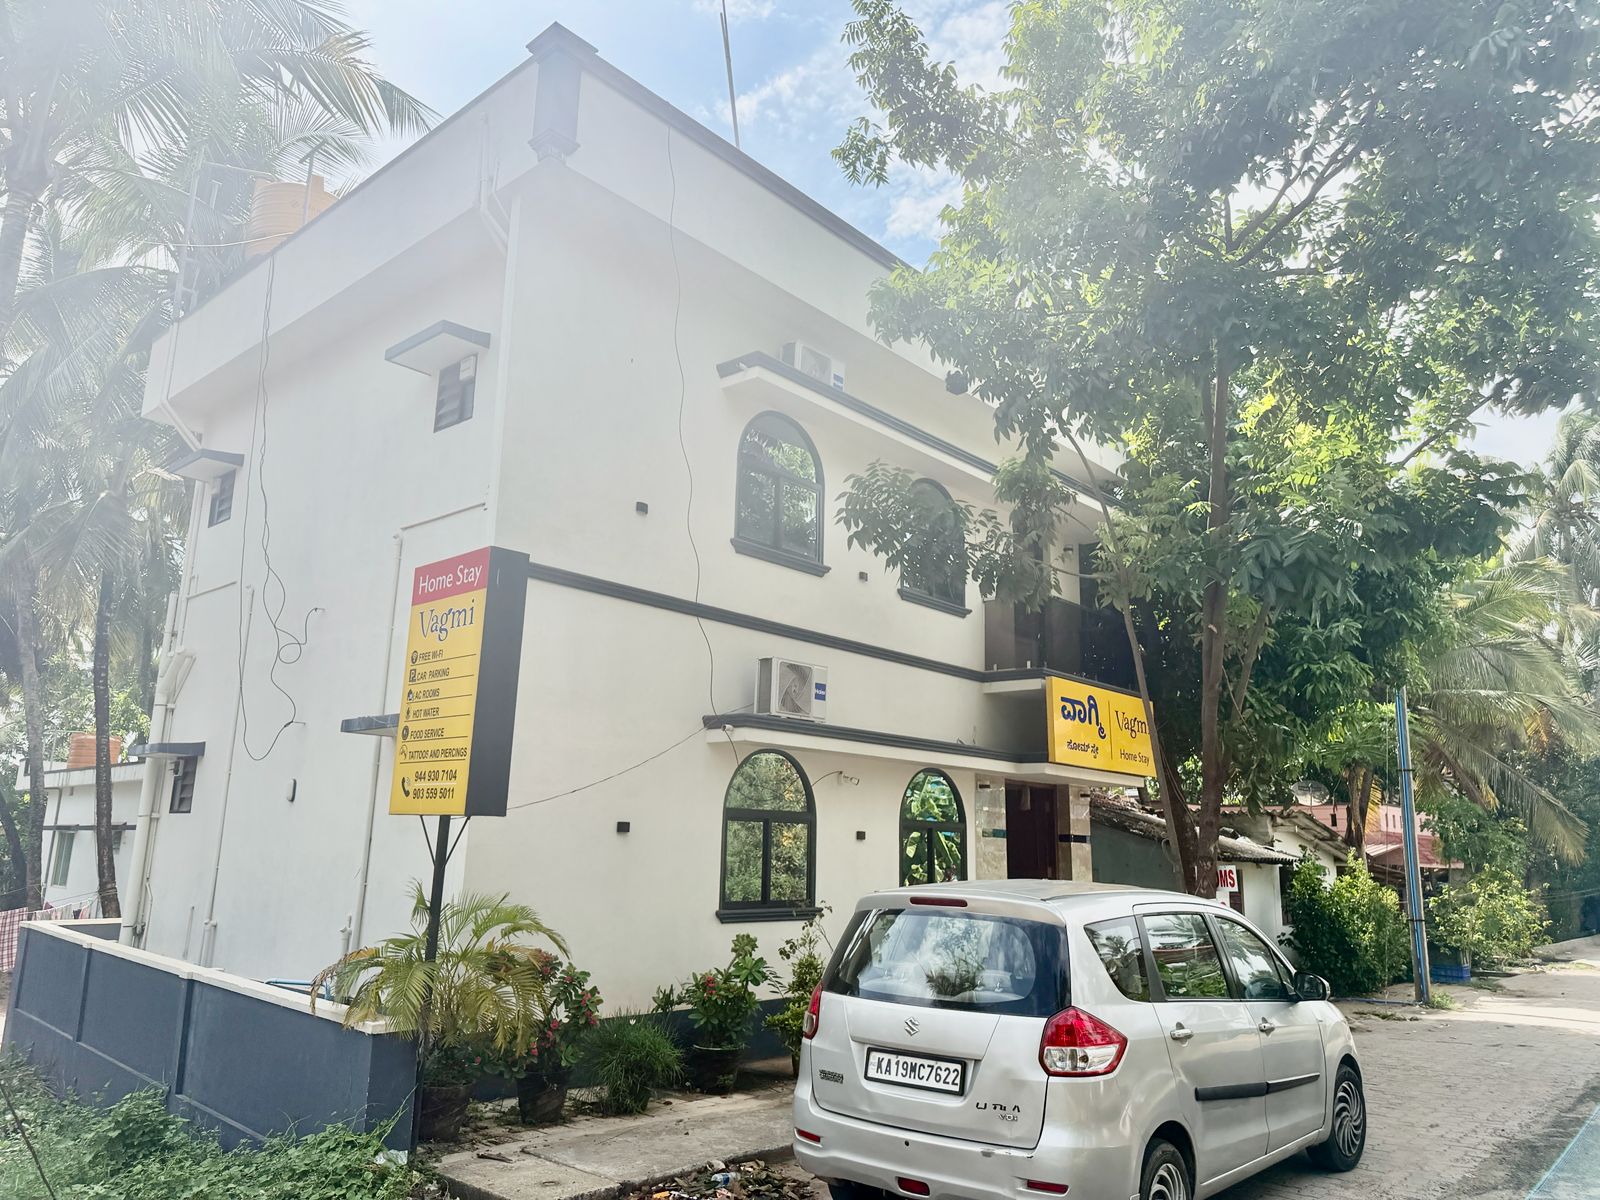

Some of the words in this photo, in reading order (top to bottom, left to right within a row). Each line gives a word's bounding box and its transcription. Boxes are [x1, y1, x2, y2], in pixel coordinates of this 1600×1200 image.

[419, 574, 453, 594] Home
[456, 564, 483, 586] Stay
[420, 598, 475, 642] Vagmi
[418, 651, 431, 661] FREE
[416, 671, 427, 681] CAR
[428, 667, 450, 679] PARKING
[414, 690, 422, 700] AC
[422, 687, 440, 699] ROOMS
[412, 708, 423, 718] HOT
[423, 706, 440, 718] WATER
[1115, 710, 1150, 739] Vagm
[410, 729, 424, 740] FOOD
[424, 727, 445, 739] SERVICE
[408, 749, 430, 760] TATTOOS
[429, 748, 441, 759] AND
[440, 747, 468, 758] PIERCINGS
[1120, 748, 1138, 762] Home
[1137, 751, 1150, 767] Stay
[414, 770, 427, 782] 944
[427, 769, 440, 782] 930
[441, 769, 458, 781] 7104
[412, 787, 425, 800] 903
[425, 787, 438, 800] 559
[438, 786, 455, 800] 5011
[875, 1056, 960, 1087] KA19MC7622
